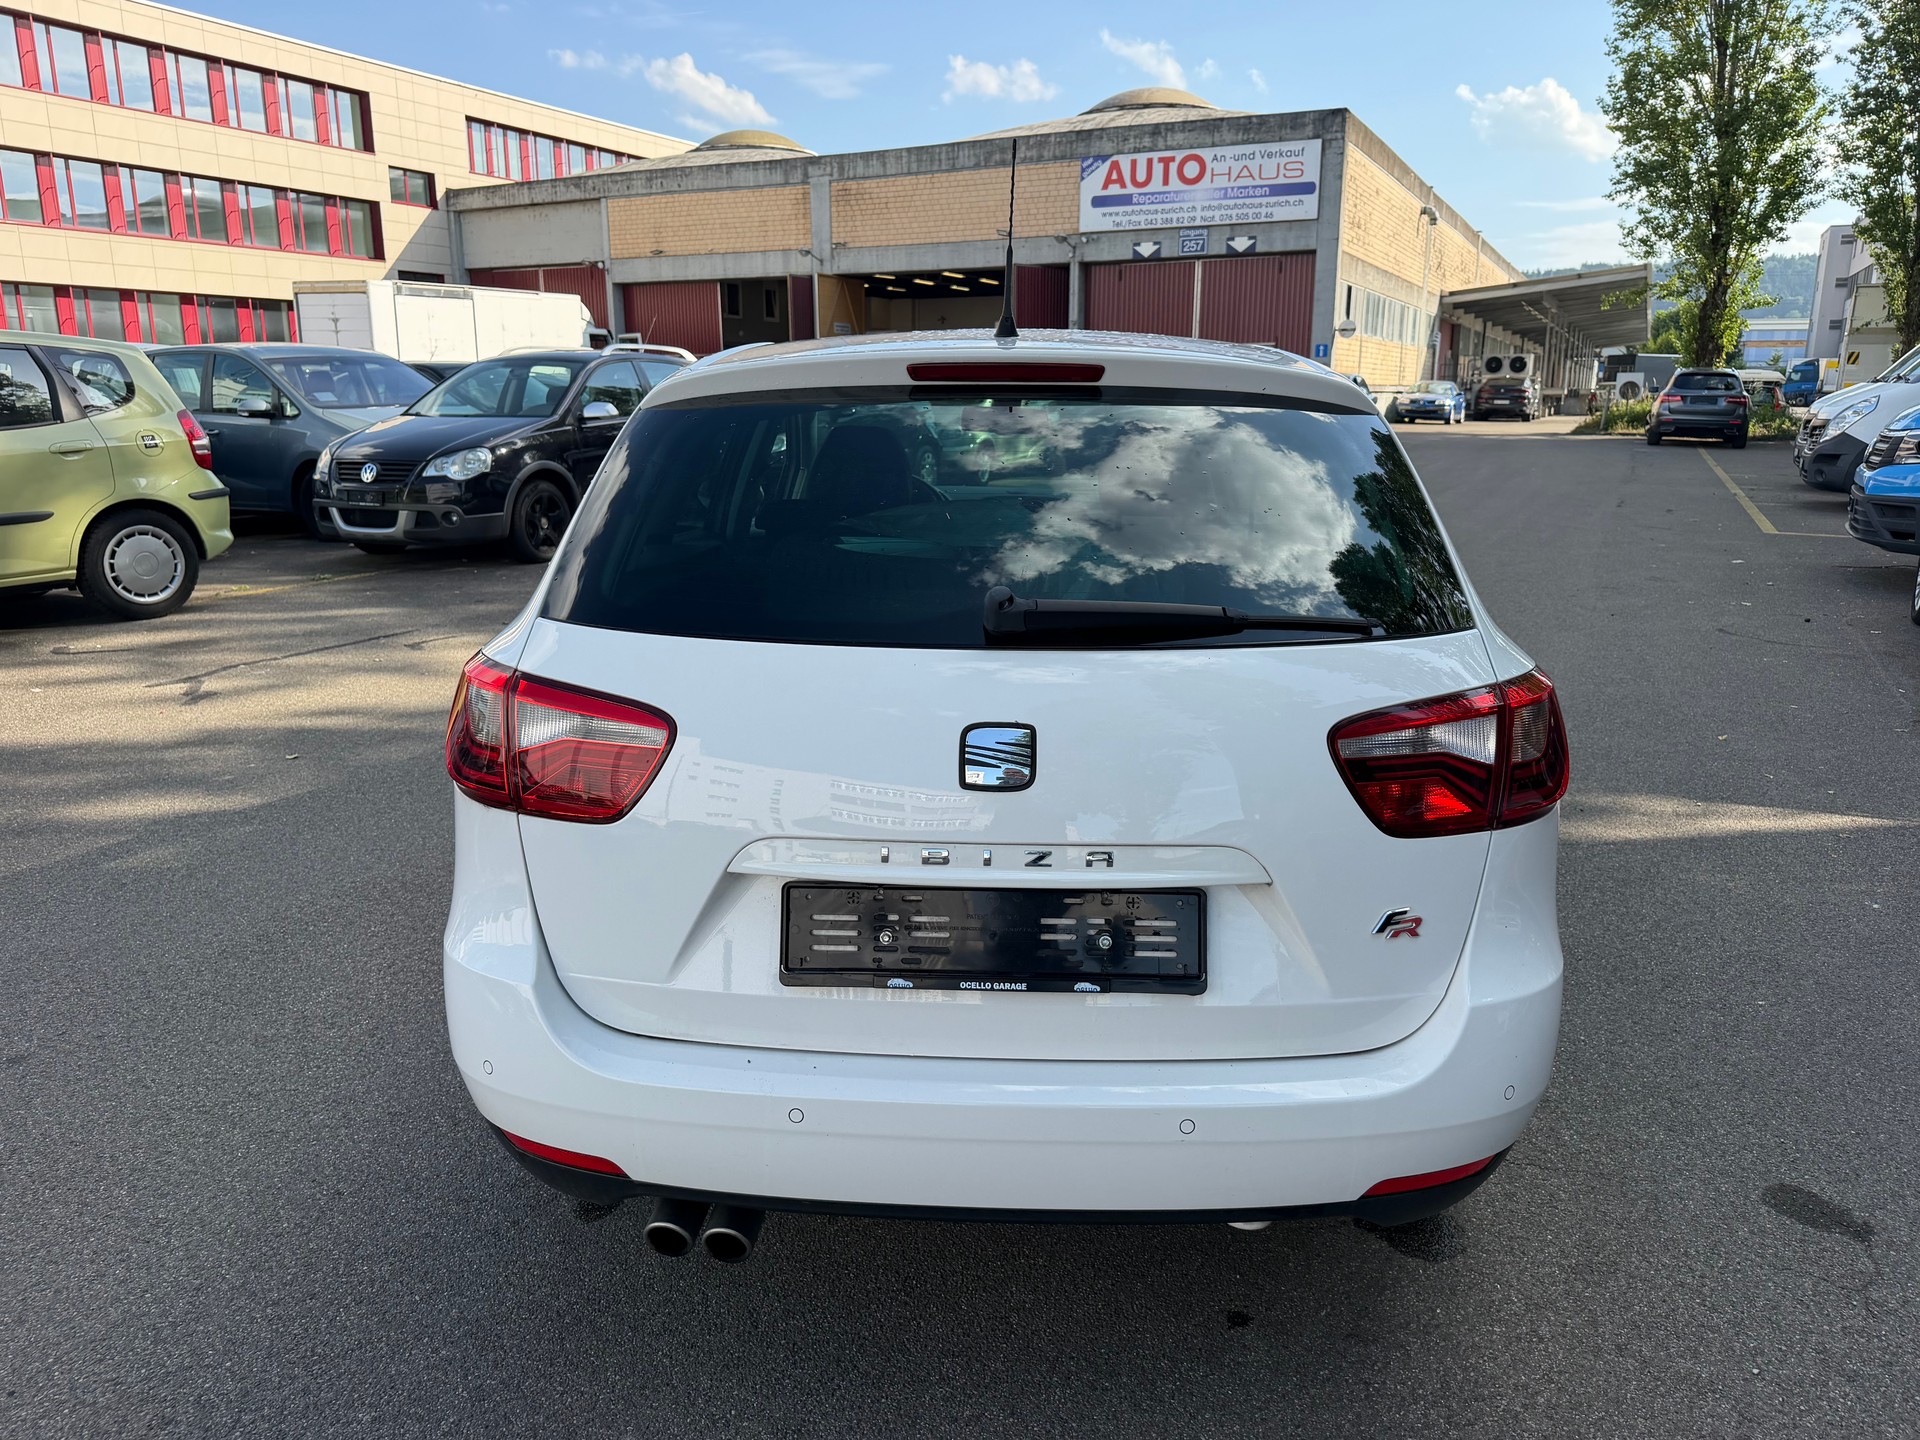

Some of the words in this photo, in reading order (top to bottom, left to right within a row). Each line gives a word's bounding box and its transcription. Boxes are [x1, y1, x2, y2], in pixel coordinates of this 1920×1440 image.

[1211, 153, 1226, 163] An
[1259, 147, 1305, 160] Verkauf
[1101, 153, 1207, 190] AUTO
[1210, 161, 1304, 184] HAUS
[1227, 187, 1270, 199] Marken
[1143, 218, 1158, 227] 043
[1186, 215, 1197, 224] 09
[1219, 212, 1233, 222] 076
[1251, 211, 1262, 220] 00
[1264, 210, 1274, 220] 46
[1183, 240, 1204, 252] 257
[1371, 906, 1423, 940] FR
[960, 981, 992, 990] OCELLO
[993, 982, 1028, 991] GARAGE
